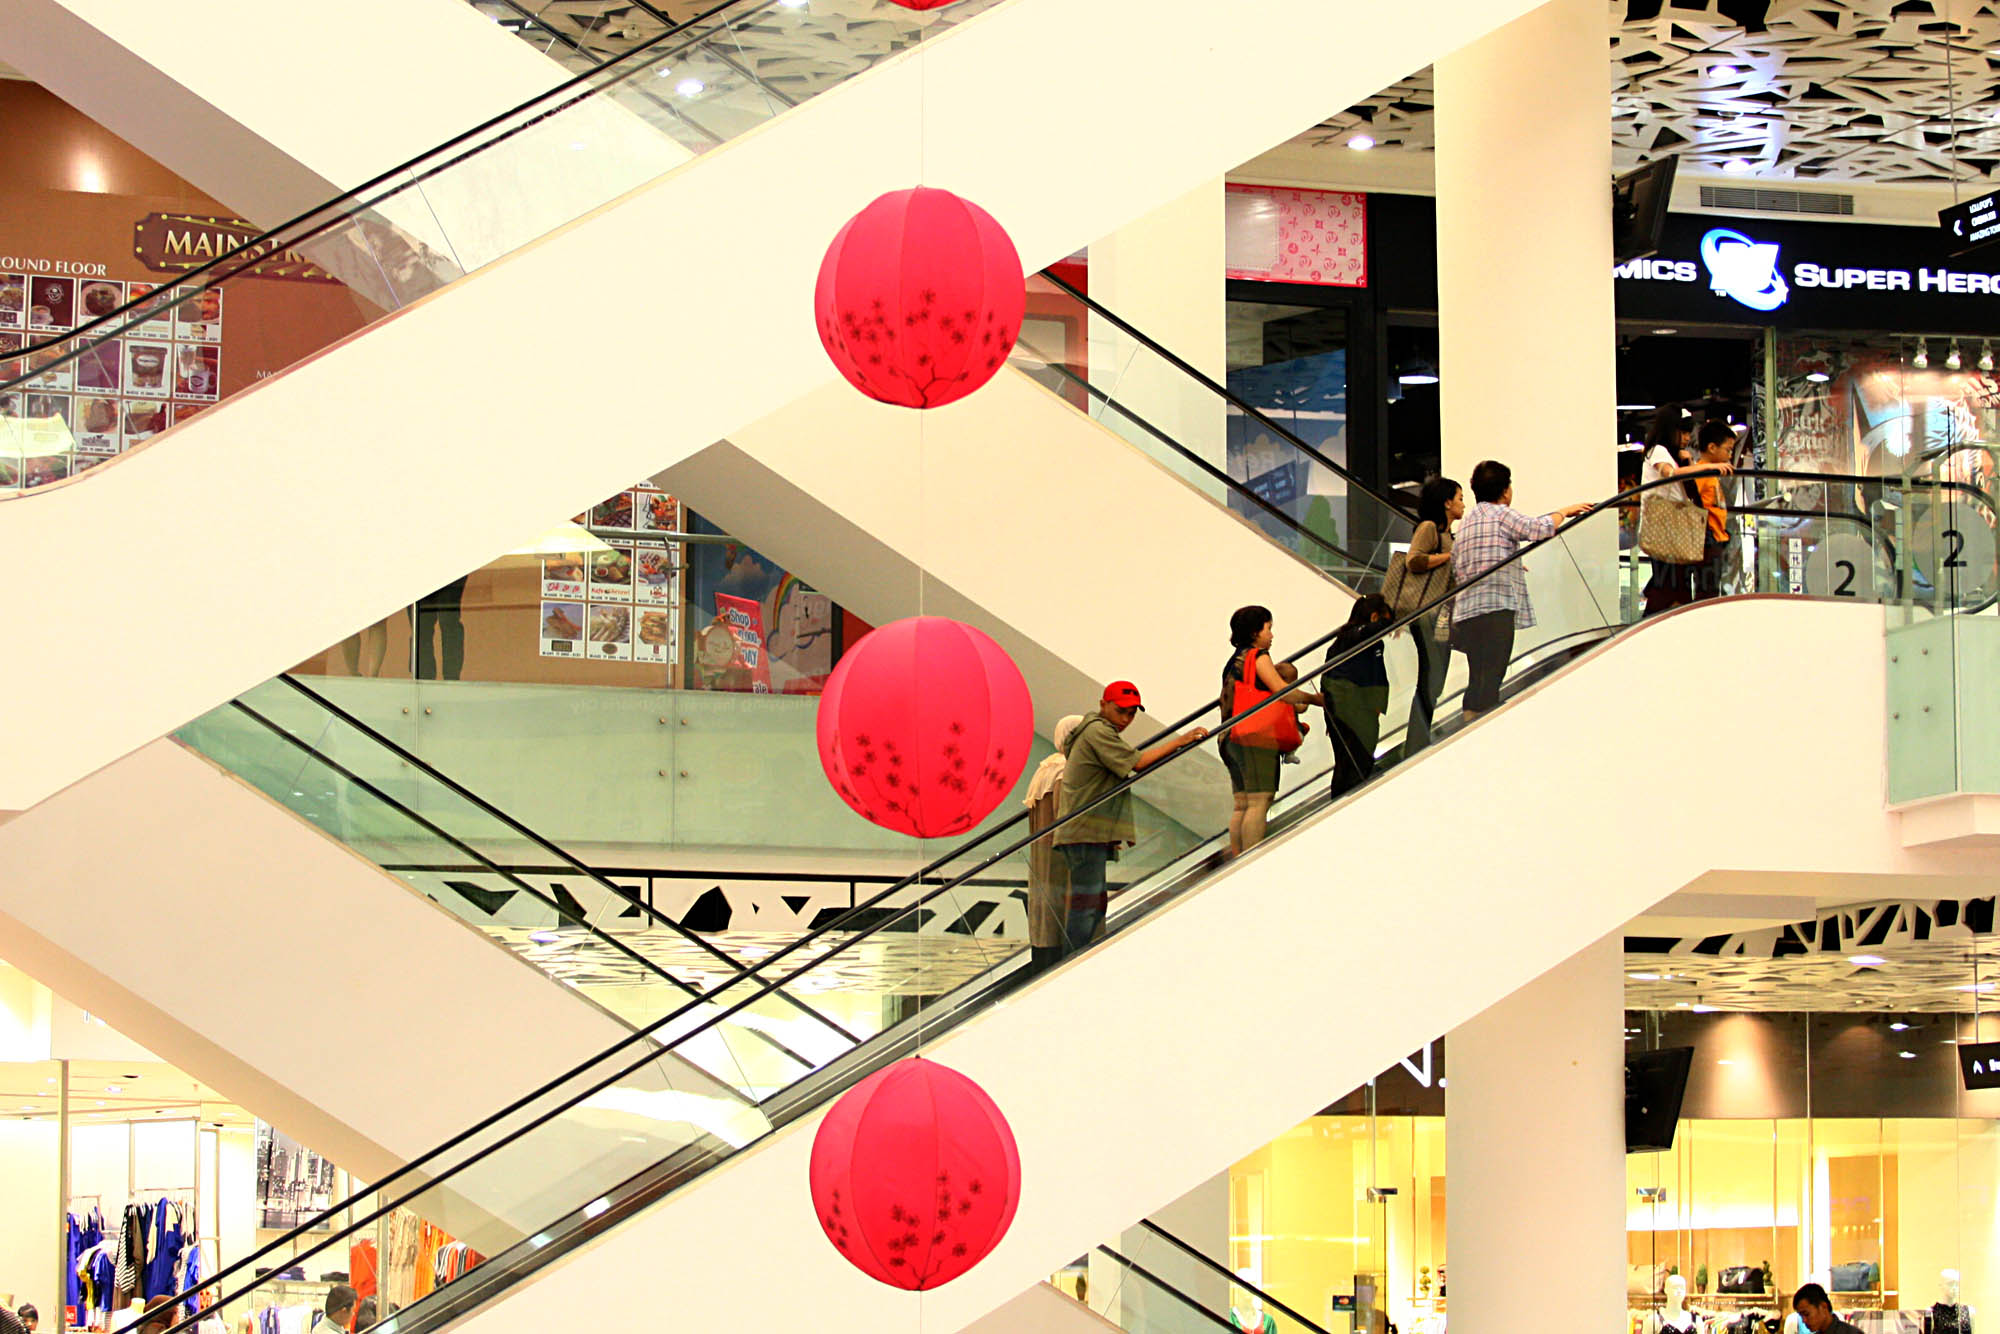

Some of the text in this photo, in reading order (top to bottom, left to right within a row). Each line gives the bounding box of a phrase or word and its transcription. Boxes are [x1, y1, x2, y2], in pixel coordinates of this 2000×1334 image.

[0, 256, 107, 277] OUND FLOOR
[1794, 263, 1911, 291] SUPER
[1941, 530, 1967, 567] 2
[1834, 560, 1856, 596] 2
[729, 608, 750, 627] Shop
